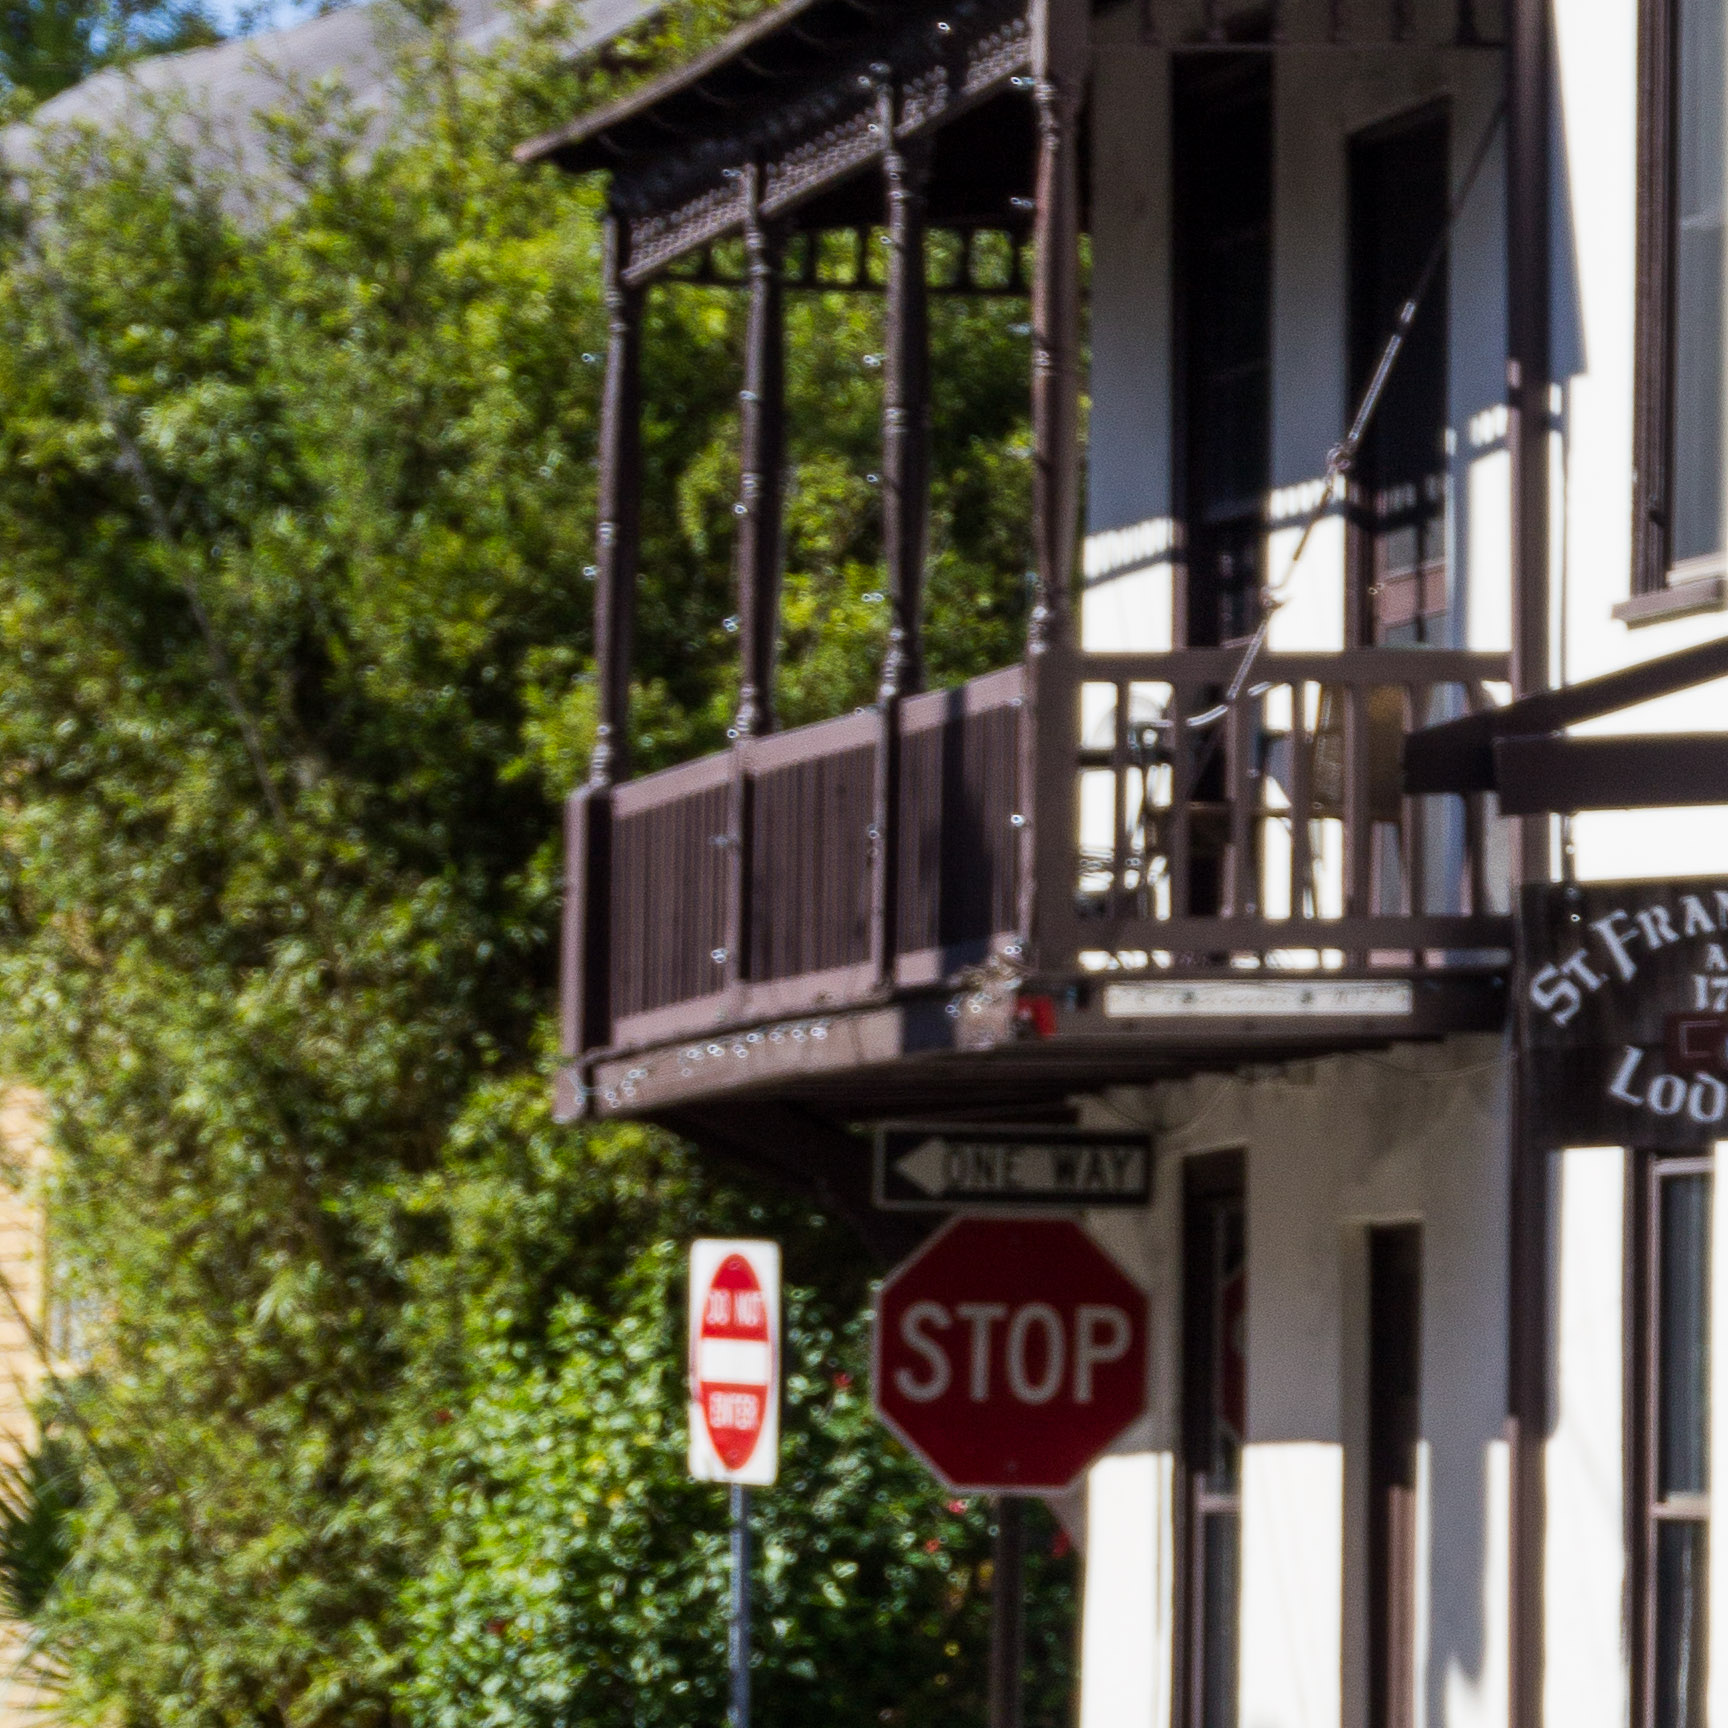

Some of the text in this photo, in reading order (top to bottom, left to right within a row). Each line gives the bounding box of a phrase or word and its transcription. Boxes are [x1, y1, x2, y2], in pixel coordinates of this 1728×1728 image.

[943, 1143, 1135, 1194] ONE WAY
[894, 1300, 1133, 1405] STOP
[709, 1392, 760, 1431] ENTER
